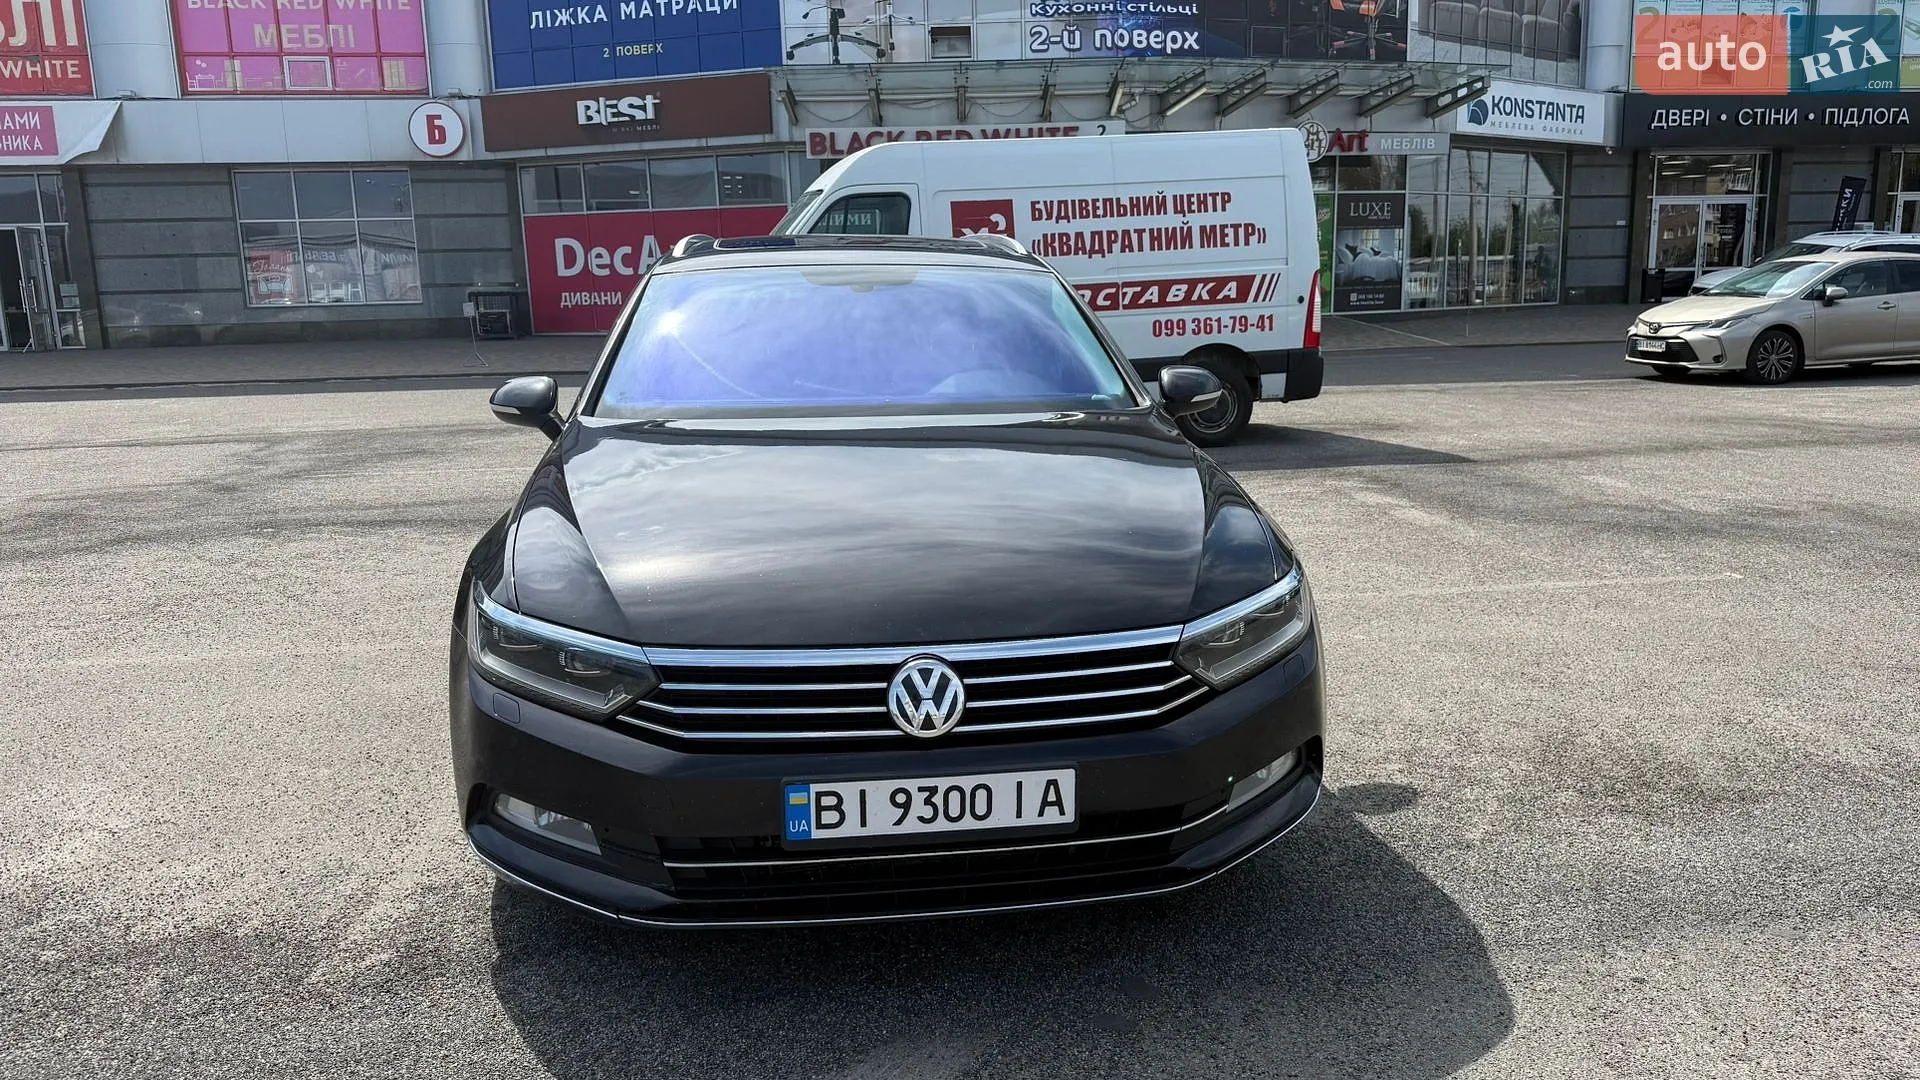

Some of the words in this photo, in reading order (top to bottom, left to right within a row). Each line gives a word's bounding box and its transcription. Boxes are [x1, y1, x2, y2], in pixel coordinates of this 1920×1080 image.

[0, 0, 78, 47] ЛІ
[530, 4, 608, 30] ЛІЖКА
[620, 0, 738, 21] МАТРАЦИ
[253, 23, 356, 49] МЕБЛІ
[1030, 24, 1082, 51] 2-й
[1094, 28, 1200, 54] поверх
[603, 47, 609, 58] 2
[0, 111, 41, 131] АМИ
[1491, 95, 1585, 124] KONSTANTA
[1651, 108, 1710, 130] ДВЕРІ
[1738, 107, 1799, 126] СТІНИ
[1824, 107, 1910, 129] ПІДЛОГА
[426, 114, 447, 146] Б
[1328, 128, 1369, 153] Art
[0, 135, 43, 151] НИКА
[1380, 138, 1436, 150] МЕБЛІВ
[1030, 190, 1168, 224] БУДІВЕЛЬНИЙ
[1172, 191, 1232, 218] ЦЕНТР
[1350, 202, 1392, 217] LUXE
[1031, 220, 1194, 259] «КВАДРАТНИЙ
[1198, 222, 1267, 250] МЕТР»
[554, 235, 676, 277] DecA
[560, 291, 623, 309] ДИВАНИ
[1152, 318, 1187, 338] 099
[1191, 313, 1274, 336] 361-79-41
[814, 789, 868, 830] BI
[889, 782, 994, 827] 9300
[1015, 778, 1067, 819] IA
[789, 819, 809, 832] UA
